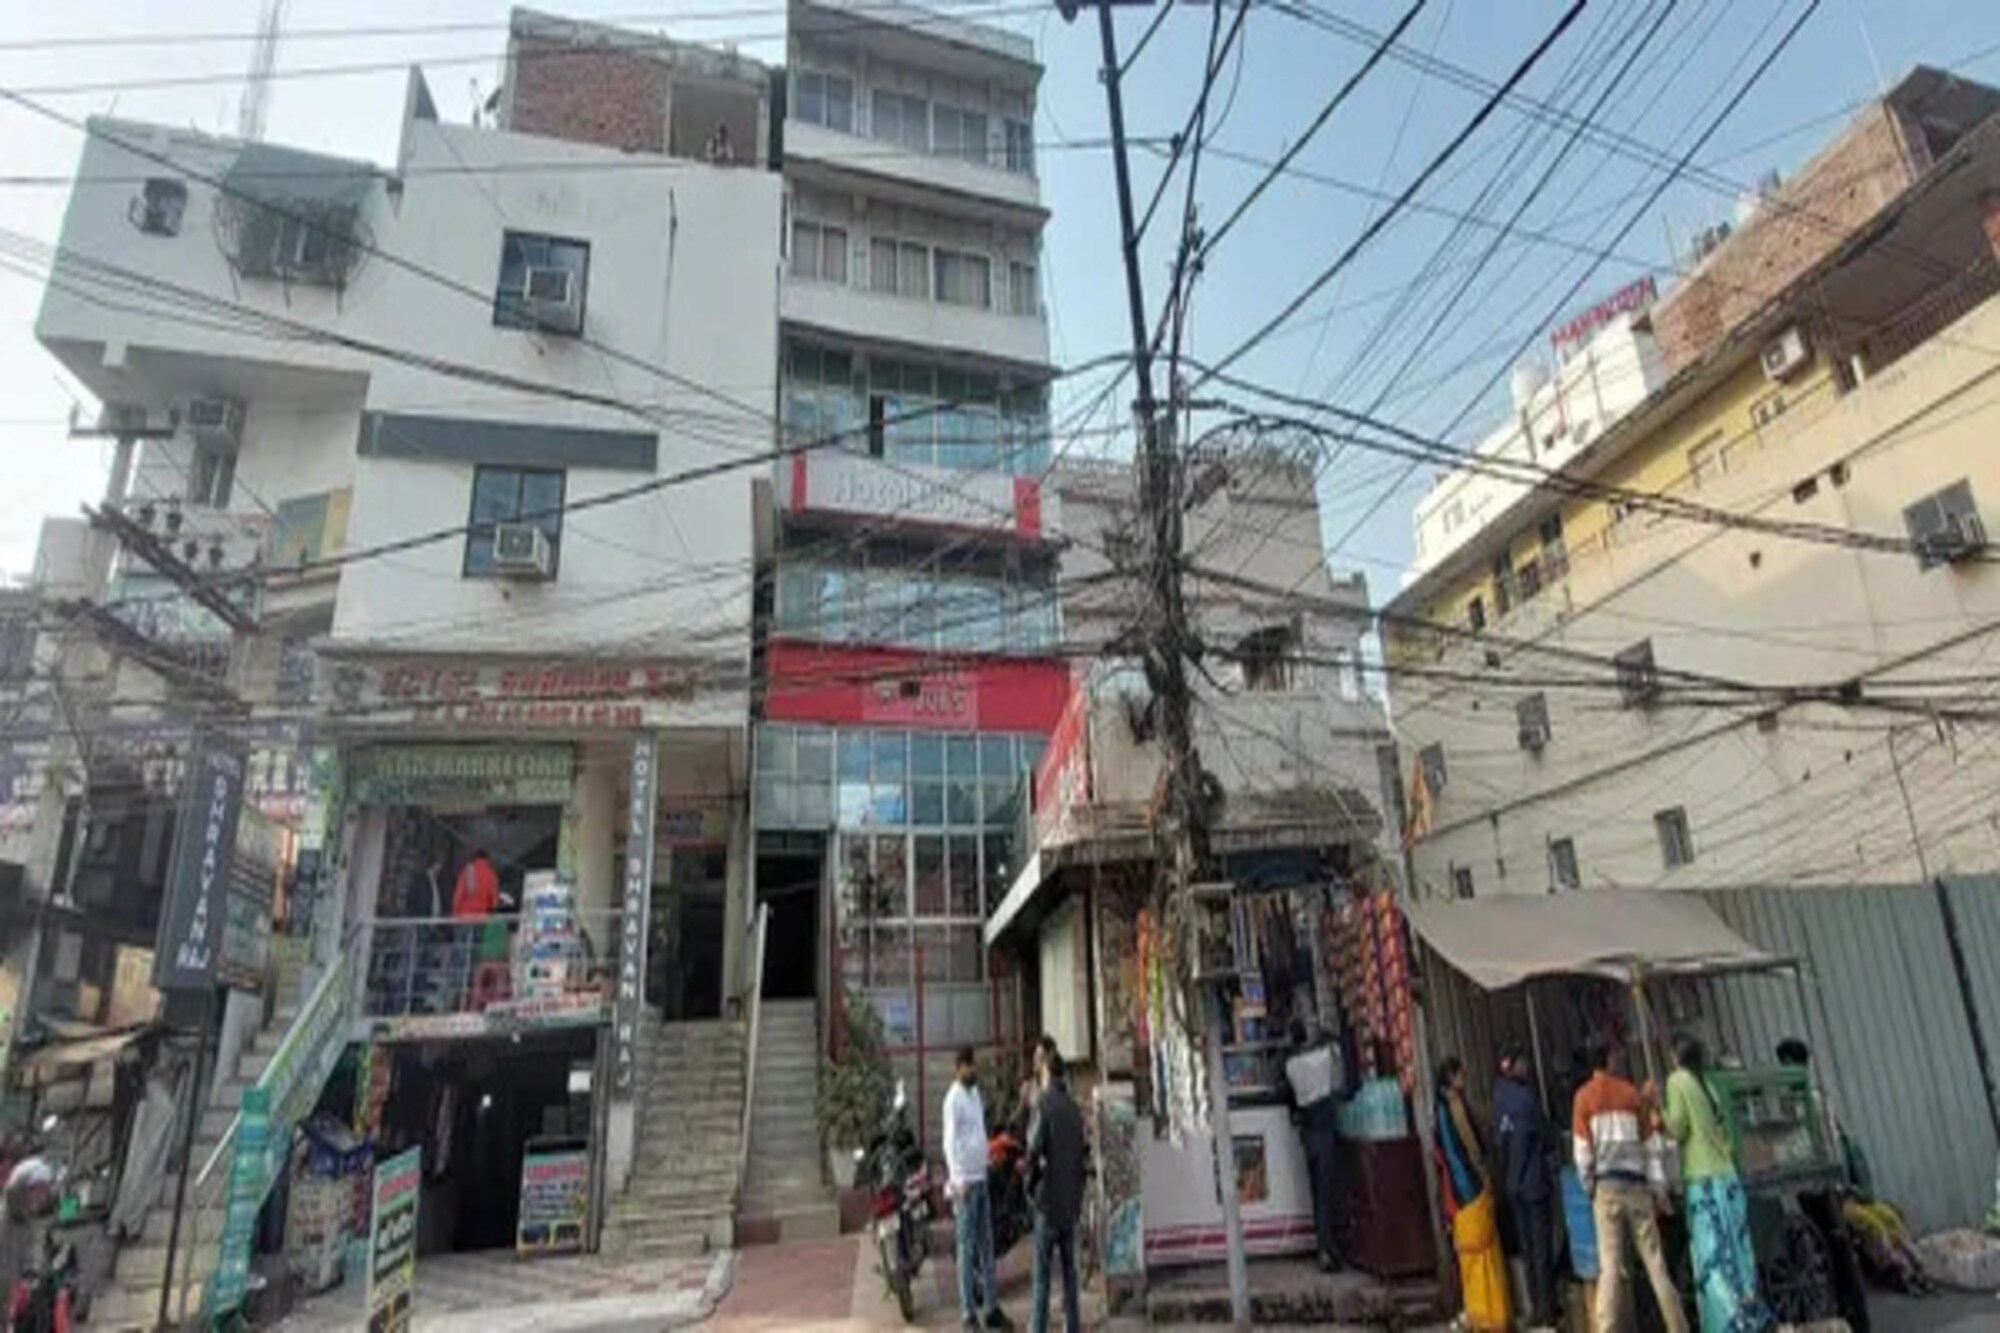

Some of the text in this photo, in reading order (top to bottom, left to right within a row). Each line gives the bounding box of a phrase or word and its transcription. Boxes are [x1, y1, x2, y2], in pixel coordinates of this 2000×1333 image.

[189, 774, 228, 942] SHRAVAN
[617, 741, 650, 1088] HOTEL SHRAVAN RAJ
